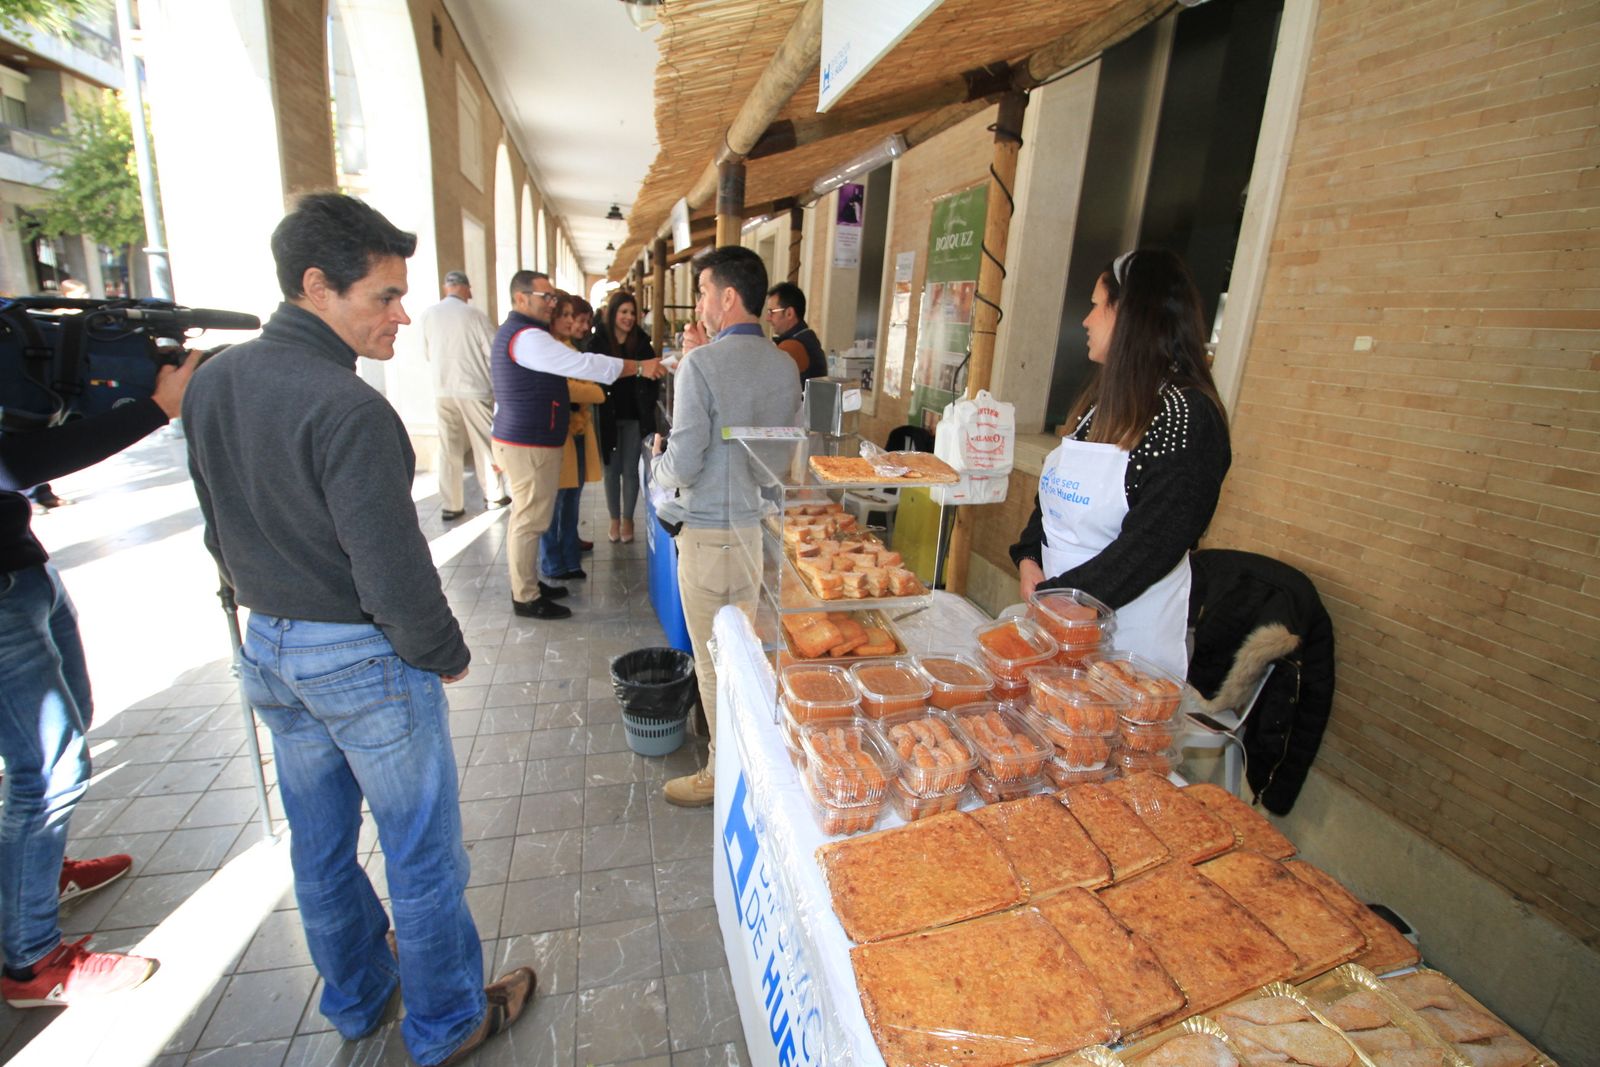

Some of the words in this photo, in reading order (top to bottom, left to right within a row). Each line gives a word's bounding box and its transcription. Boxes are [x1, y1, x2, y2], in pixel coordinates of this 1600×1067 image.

[1062, 479, 1080, 490] sea
[1057, 488, 1090, 505] Huelva
[745, 888, 767, 960] DE
[762, 951, 799, 1067] HUE
